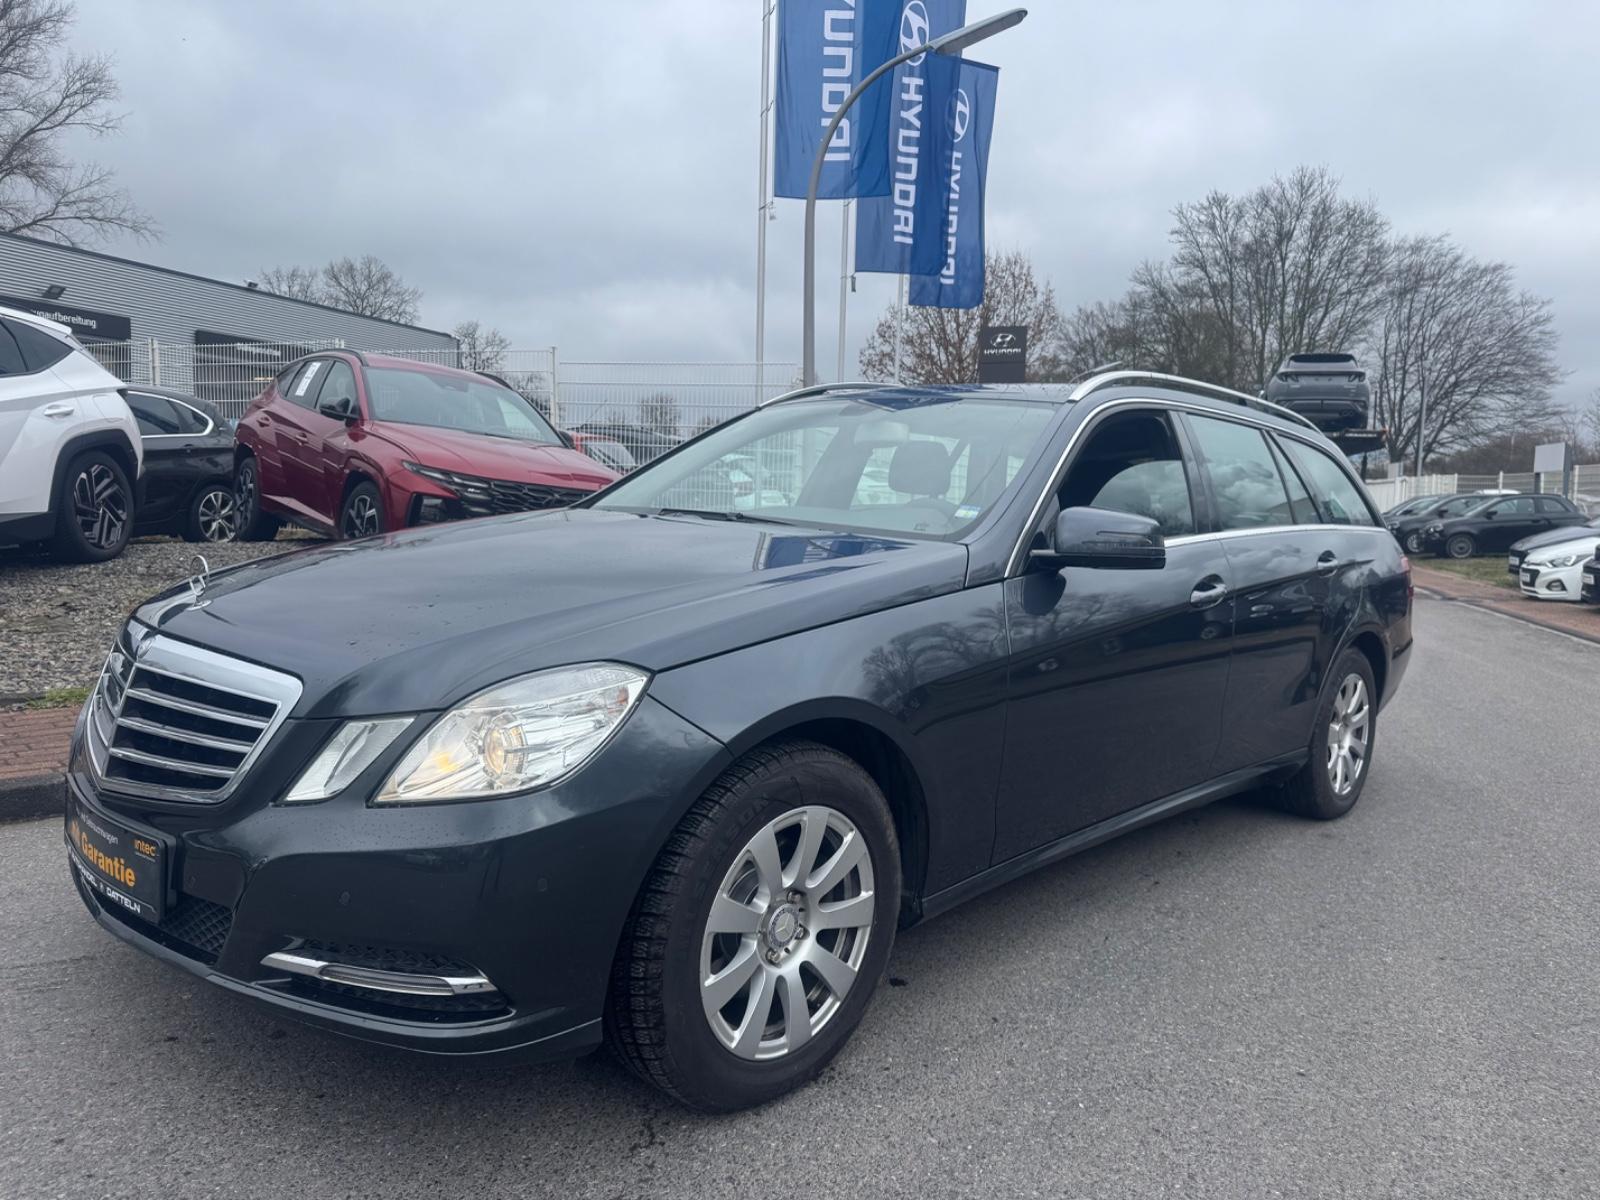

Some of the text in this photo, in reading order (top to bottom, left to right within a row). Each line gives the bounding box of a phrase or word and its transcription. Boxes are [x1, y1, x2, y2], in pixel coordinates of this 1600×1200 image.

[820, 0, 856, 161] UNDAI
[893, 76, 924, 245] HYUNDAI
[81, 831, 136, 888] Garantie
[105, 890, 141, 914] DATTELN
